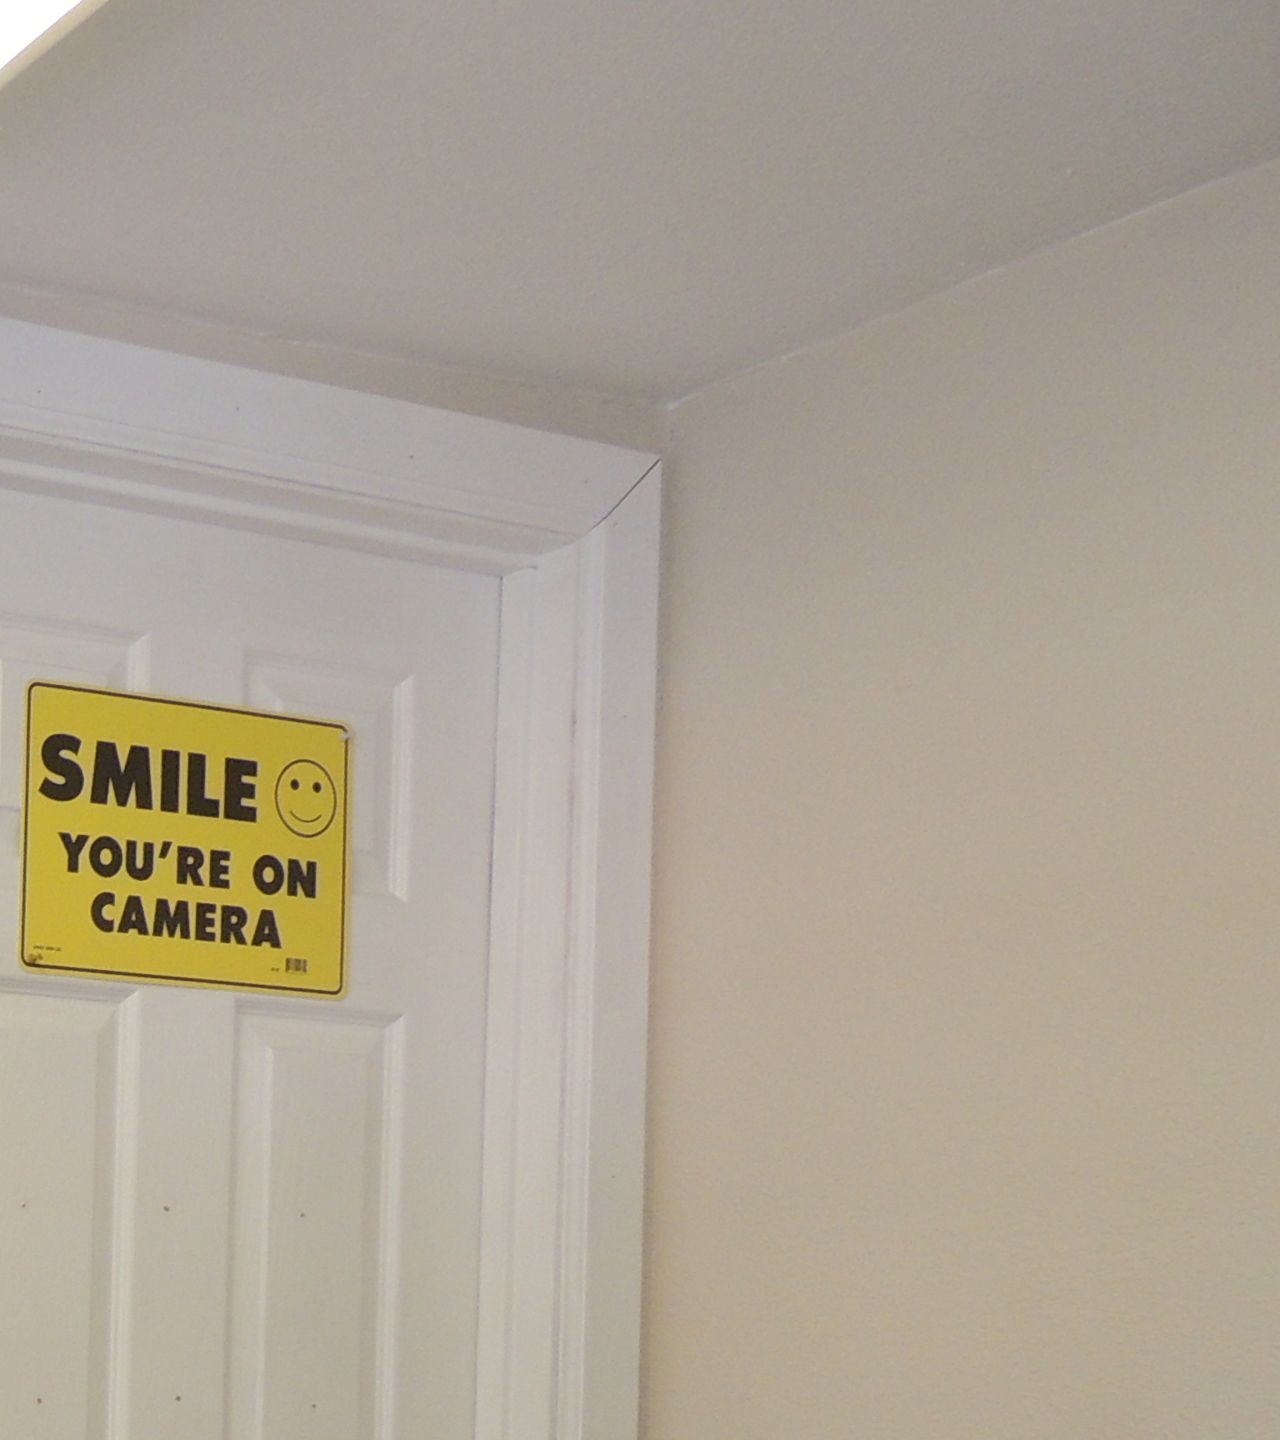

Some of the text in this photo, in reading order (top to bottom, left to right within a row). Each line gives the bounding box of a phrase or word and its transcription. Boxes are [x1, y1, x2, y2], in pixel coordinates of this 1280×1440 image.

[38, 733, 258, 823] SMILE
[59, 832, 317, 899] YOU'RE ON
[91, 892, 282, 949] CAMERA
